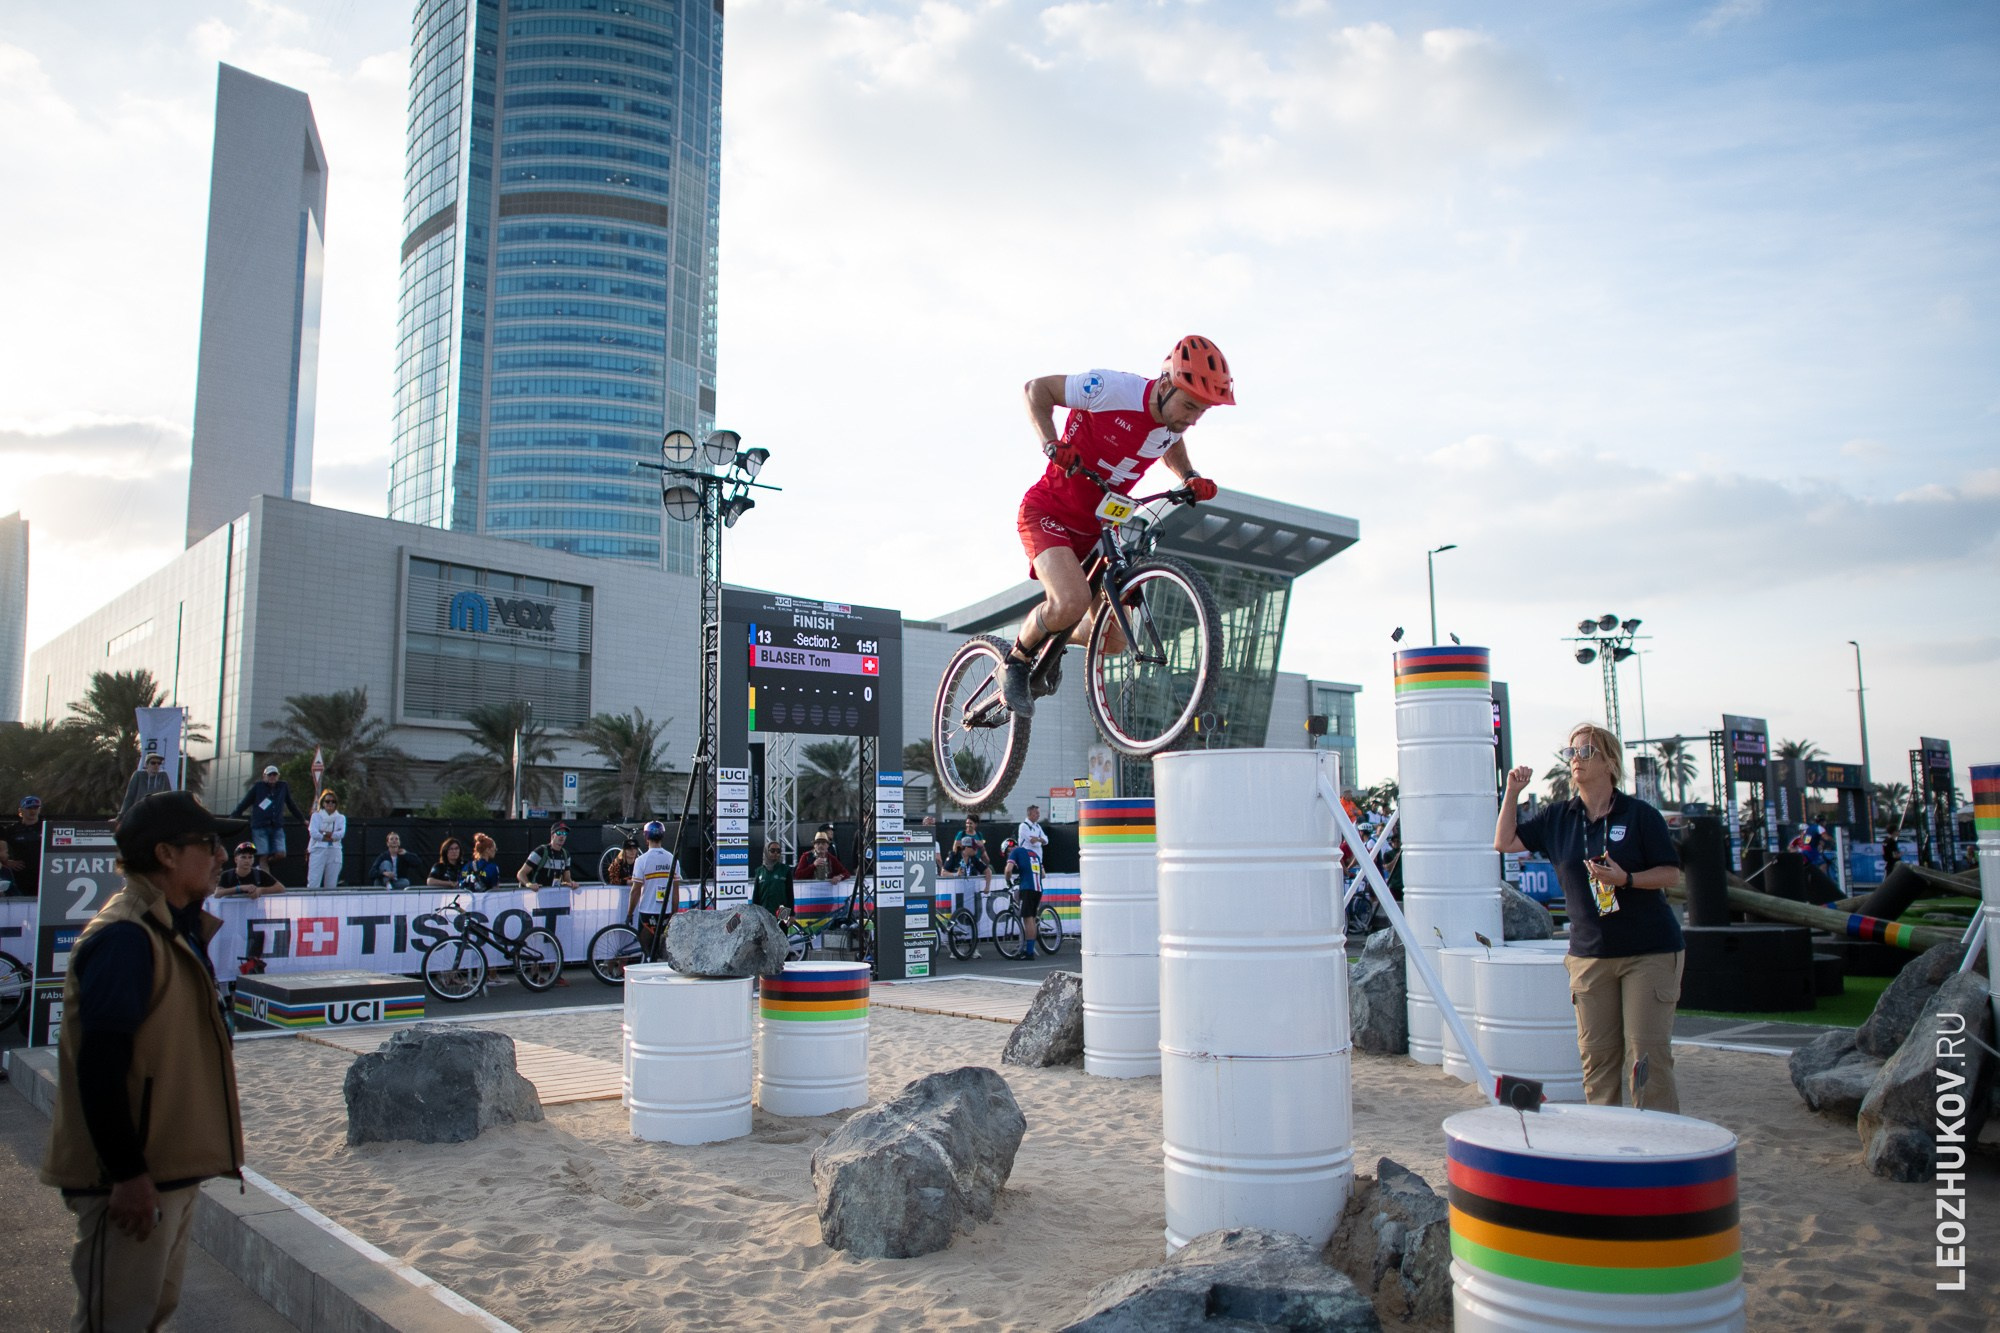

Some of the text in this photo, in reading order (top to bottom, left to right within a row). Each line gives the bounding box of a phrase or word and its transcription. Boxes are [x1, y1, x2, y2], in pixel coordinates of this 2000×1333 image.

[1110, 505, 1126, 517] 13
[777, 598, 791, 606] UCI
[494, 597, 557, 632] VOX
[793, 614, 835, 631] FINISH
[757, 630, 772, 644] 13
[793, 632, 841, 649] -Section 2-
[856, 640, 878, 654] 1:51
[761, 650, 831, 668] BLASER Tom
[863, 686, 873, 702] 0
[145, 738, 158, 754] bi
[567, 775, 576, 788] P
[725, 770, 746, 780] UCI
[50, 858, 116, 874] START
[884, 879, 902, 889] UCI
[909, 863, 926, 894] 2
[724, 885, 746, 895] UCI
[65, 877, 98, 920] 2
[346, 906, 571, 955] TISSOT
[251, 997, 267, 1021] UCI
[327, 1001, 380, 1025] UCI
